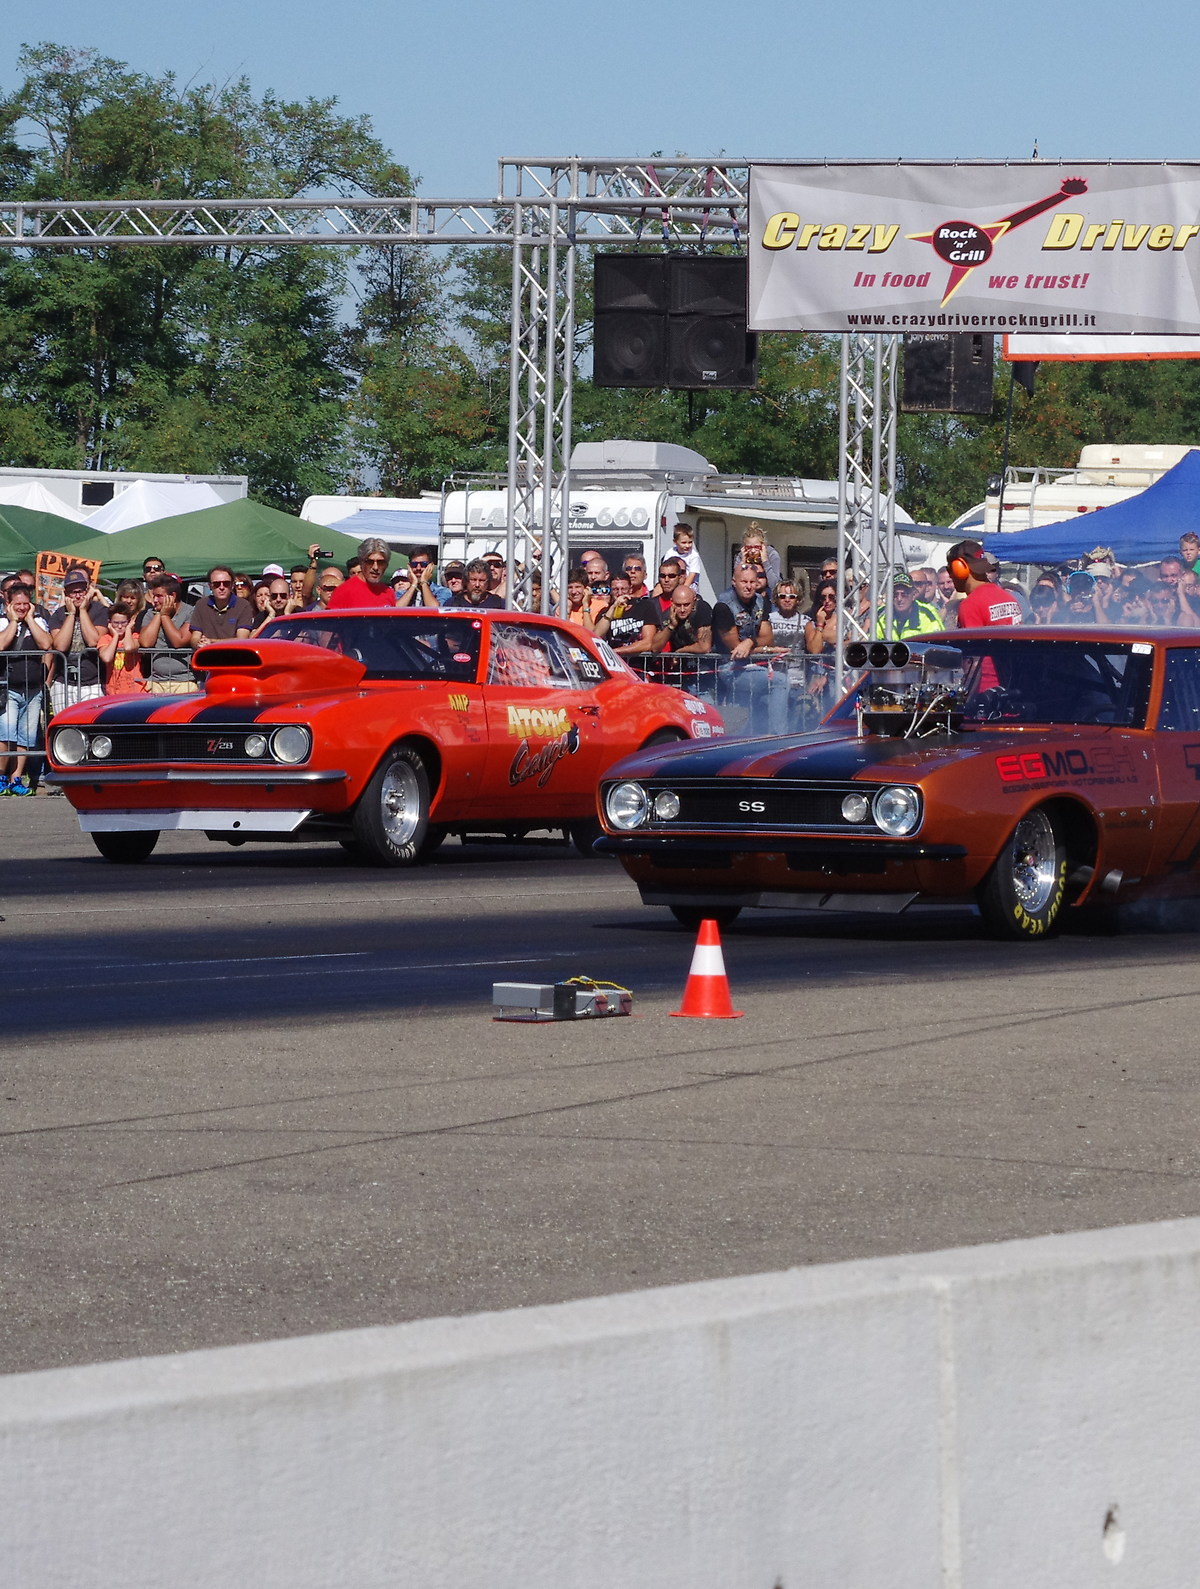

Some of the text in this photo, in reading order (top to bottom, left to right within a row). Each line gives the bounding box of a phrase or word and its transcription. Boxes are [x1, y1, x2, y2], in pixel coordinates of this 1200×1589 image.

[761, 211, 900, 254] Crazy
[939, 227, 978, 239] Rock
[1041, 212, 1199, 252] Driver
[949, 250, 986, 261] Grill
[853, 271, 931, 288] In food
[988, 272, 1091, 290] we trust!
[847, 311, 1097, 329] www.crazydriverrockngrill.it
[595, 507, 648, 528] 660
[448, 694, 470, 712] AMP
[506, 704, 572, 739] ATOMIC
[207, 737, 234, 755] Z/28
[738, 800, 766, 813] SS
